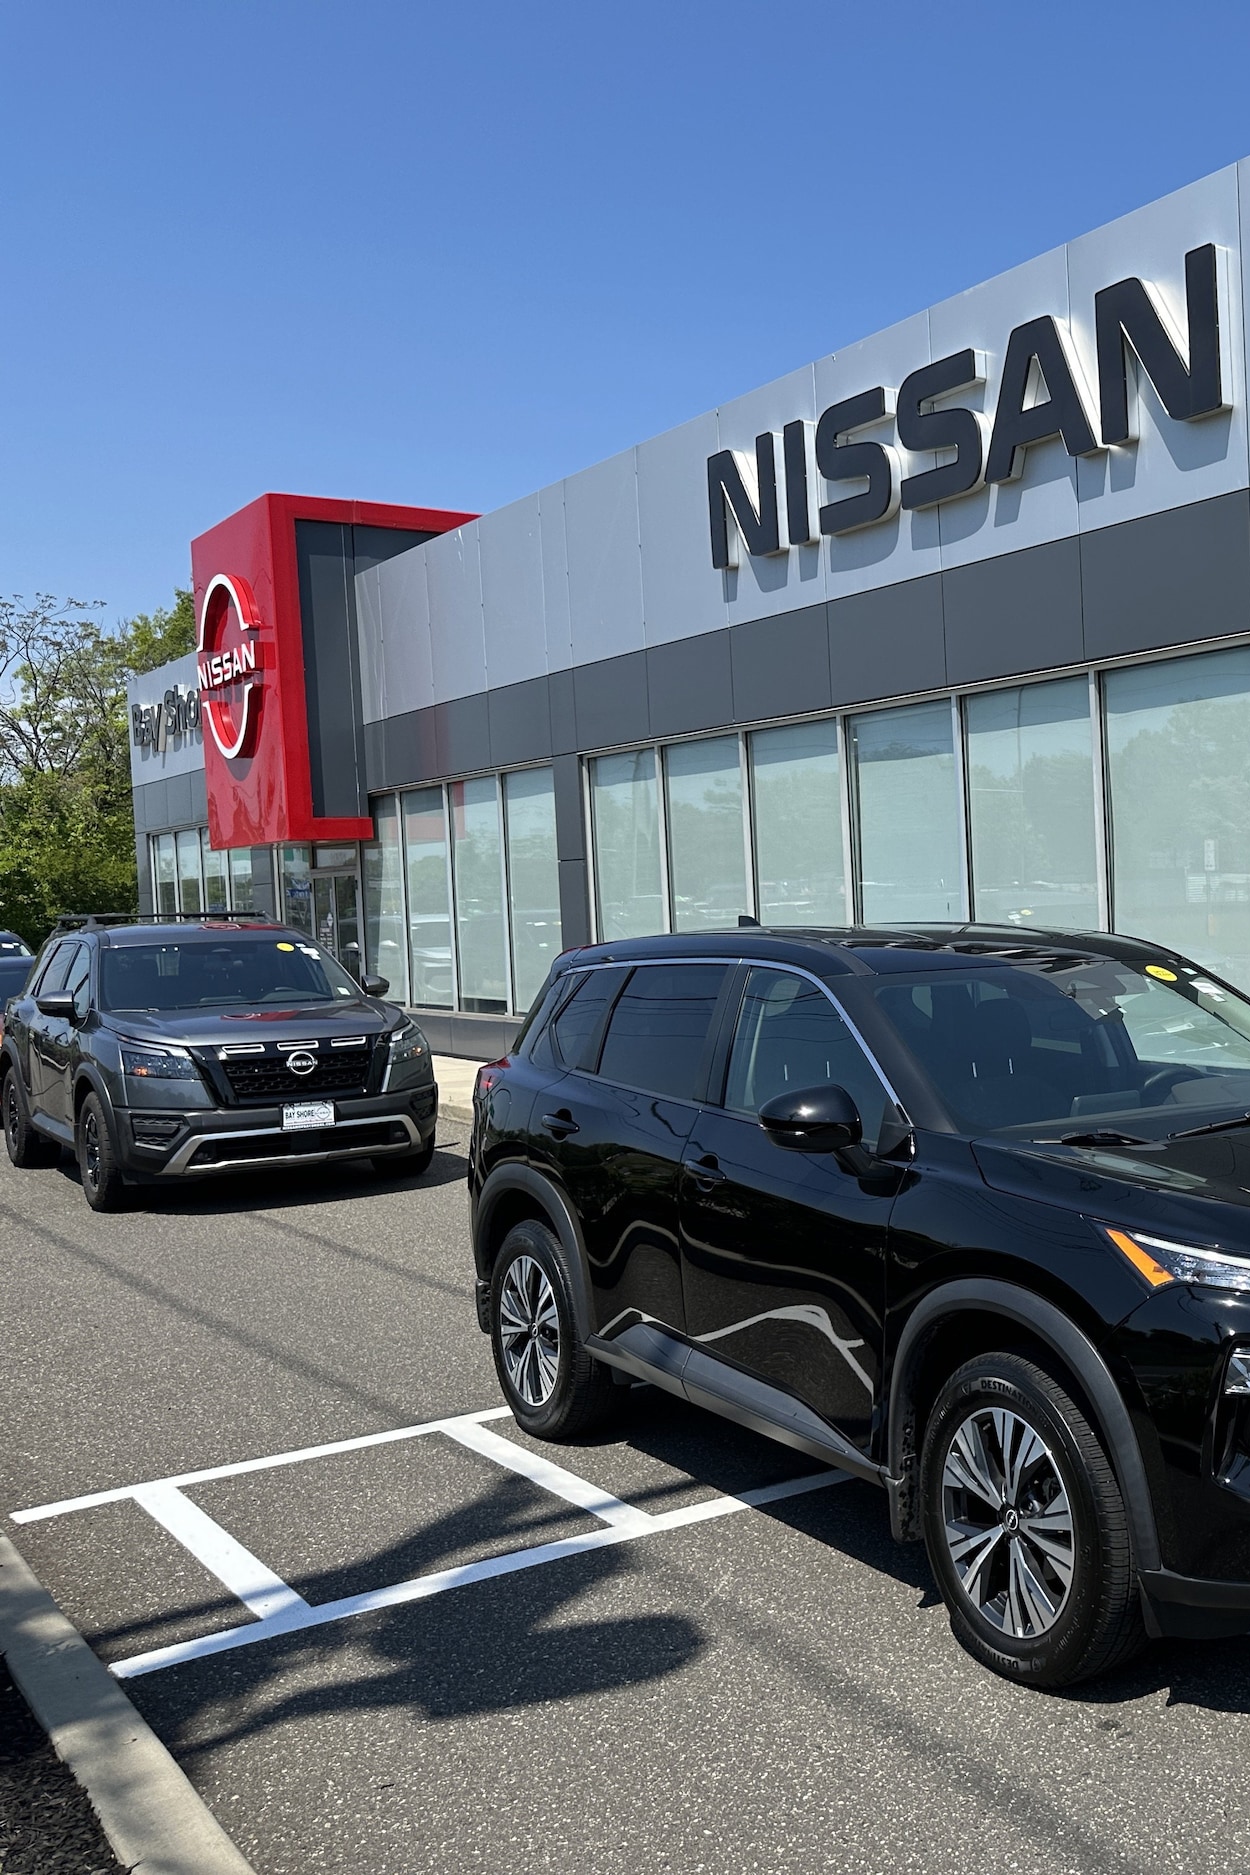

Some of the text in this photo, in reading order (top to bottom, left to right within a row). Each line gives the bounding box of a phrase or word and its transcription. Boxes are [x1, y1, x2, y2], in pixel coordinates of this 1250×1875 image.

[708, 243, 1228, 570] NISSAN
[197, 640, 255, 692] NISSAN
[132, 703, 163, 753] Bay
[286, 1060, 318, 1068] NISSAN
[285, 1112, 295, 1120] BAY
[296, 1109, 315, 1119] SHORE
